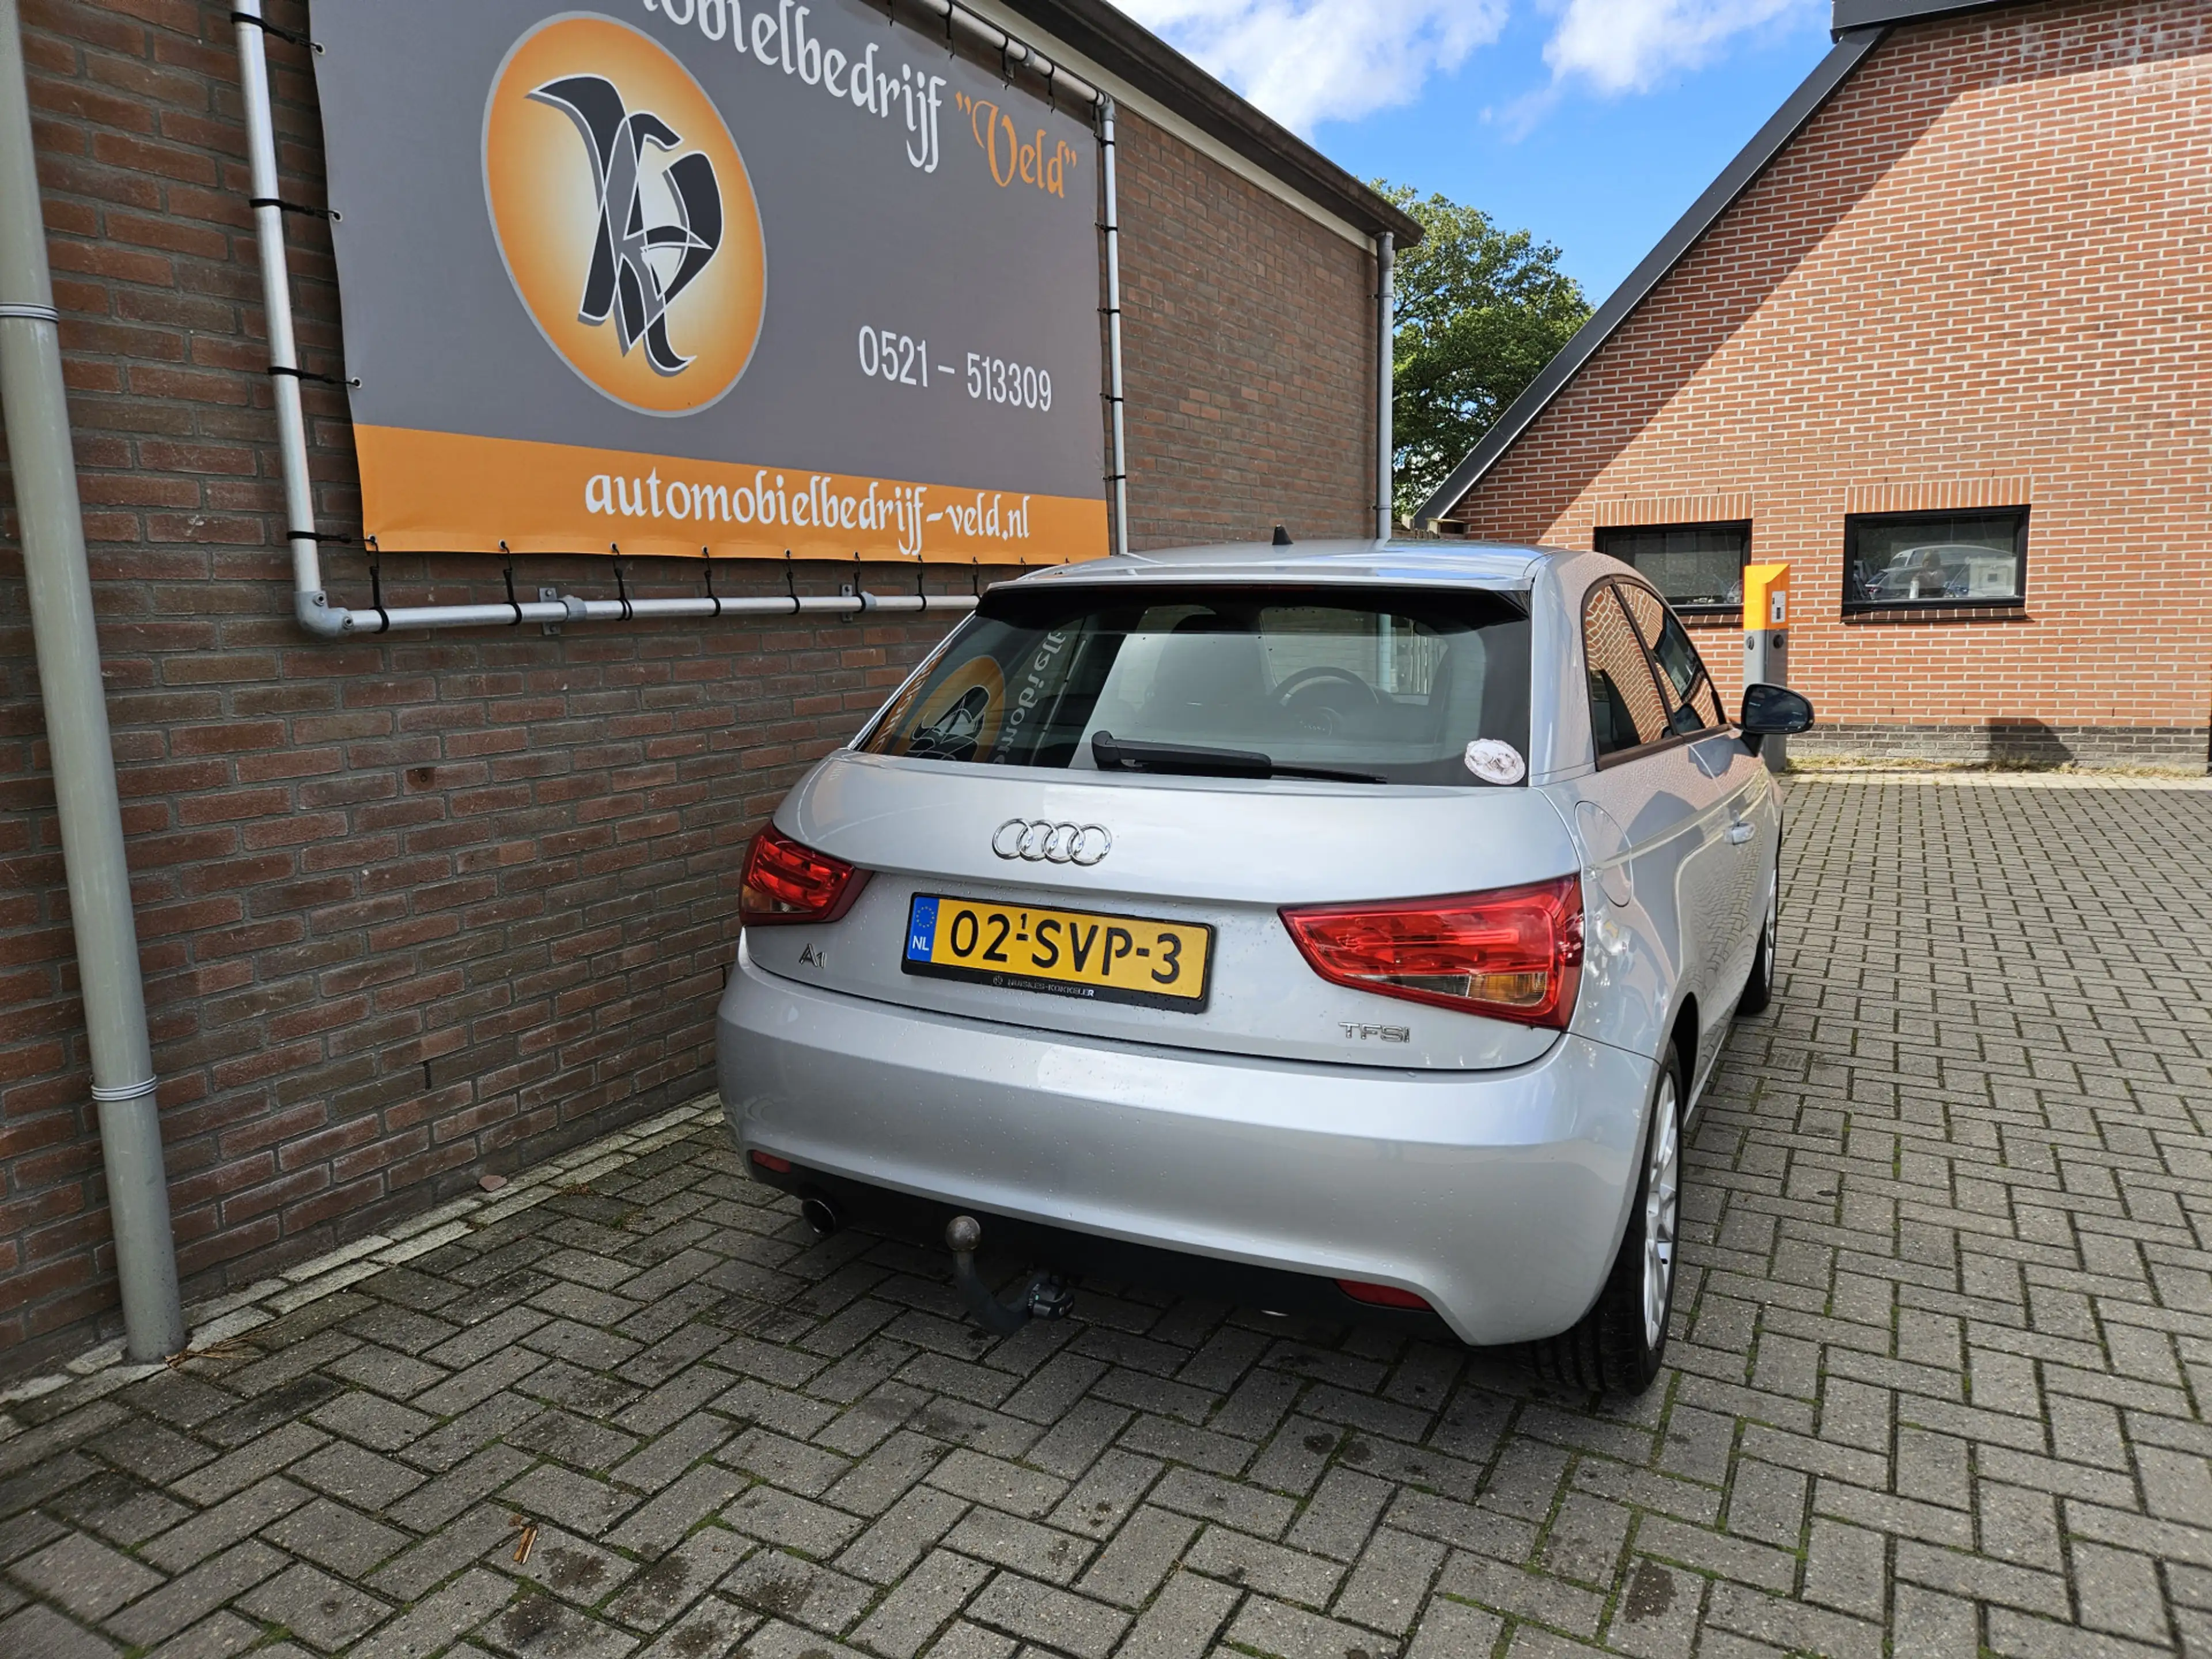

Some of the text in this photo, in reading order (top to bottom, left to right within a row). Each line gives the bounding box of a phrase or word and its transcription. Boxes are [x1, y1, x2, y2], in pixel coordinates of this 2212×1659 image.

[858, 324, 929, 388] 0521
[967, 352, 1052, 411] 513309
[585, 467, 1030, 555] automobielbedrijf-veld.nl
[798, 942, 826, 969] A1
[912, 935, 930, 952] NL
[1338, 1022, 1410, 1043] TFSI
